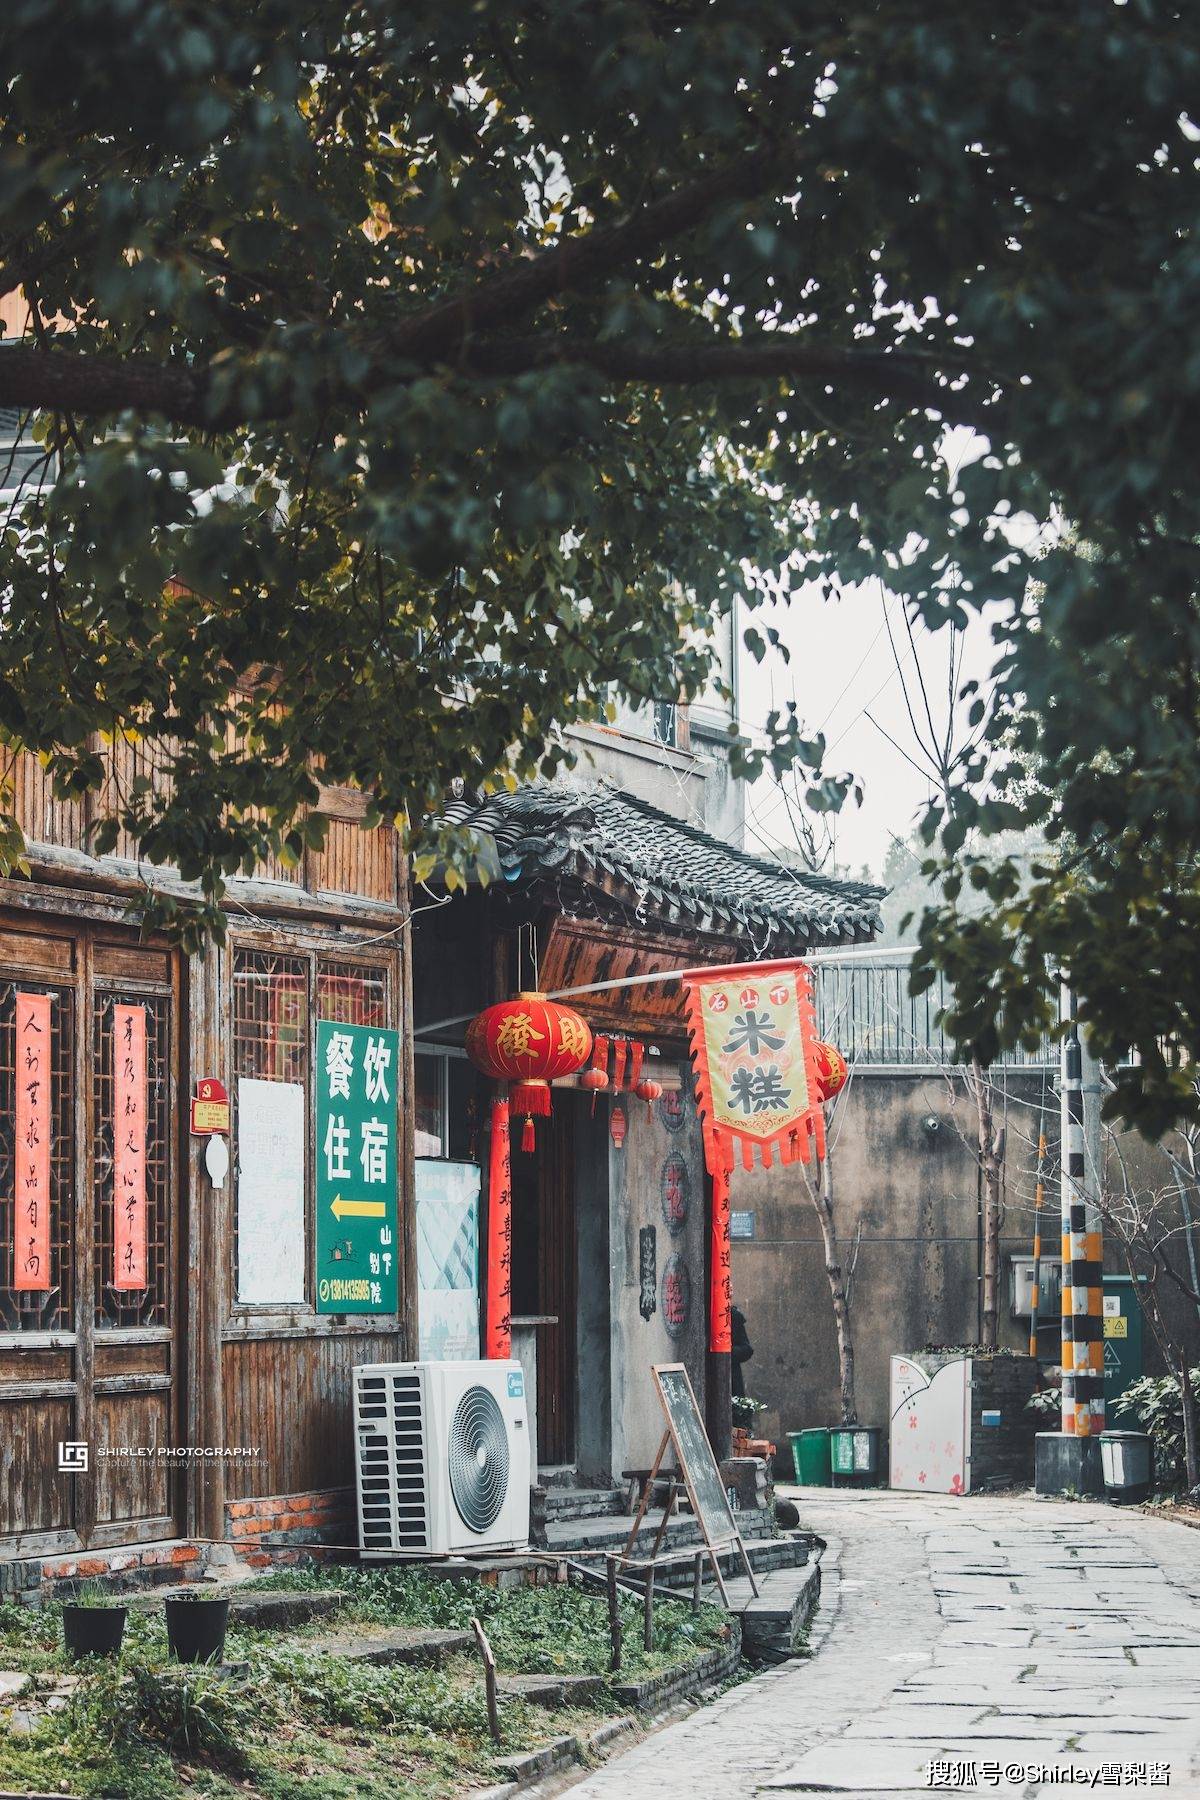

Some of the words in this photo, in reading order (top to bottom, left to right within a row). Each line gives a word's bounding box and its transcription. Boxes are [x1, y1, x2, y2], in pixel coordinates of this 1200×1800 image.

[325, 1031, 391, 1104] 餐饮
[721, 1010, 792, 1114] 米糕
[323, 1113, 388, 1183] 住宿
